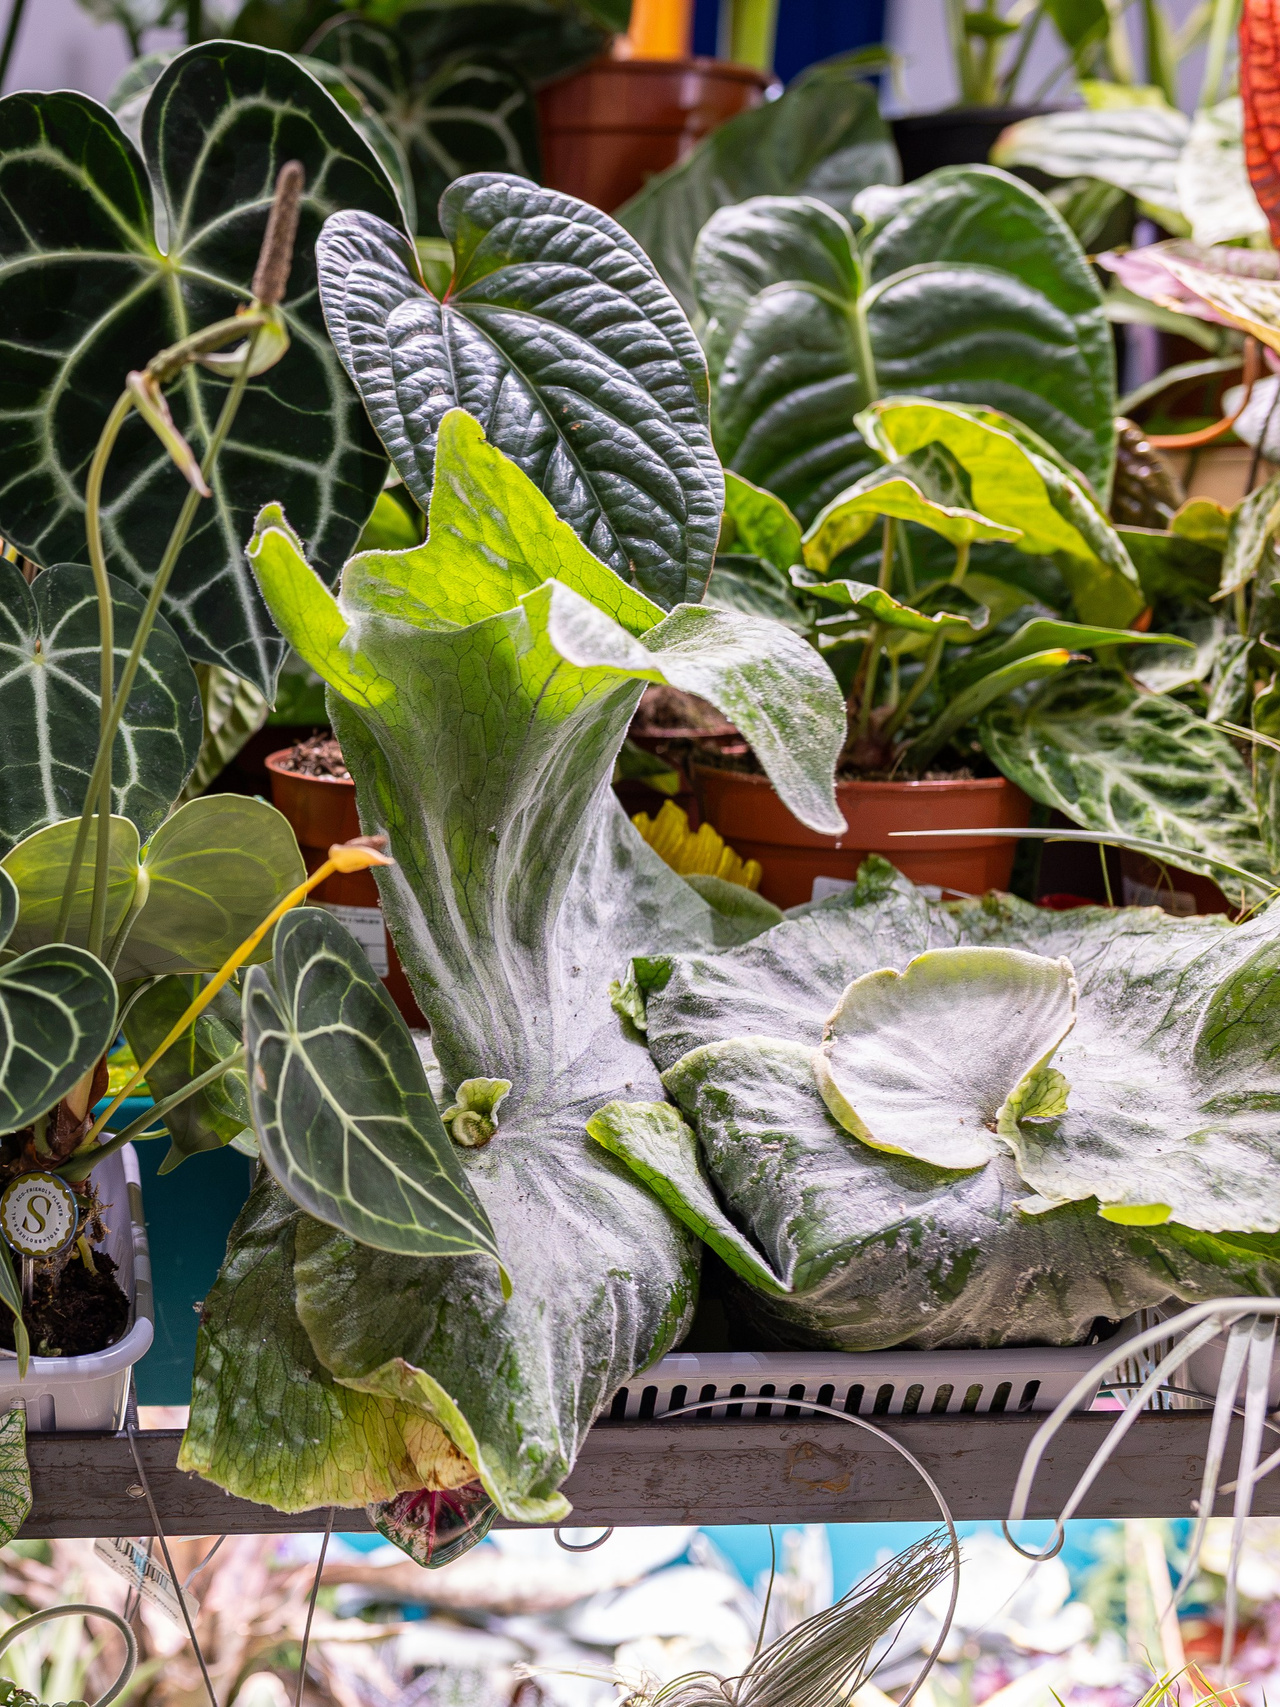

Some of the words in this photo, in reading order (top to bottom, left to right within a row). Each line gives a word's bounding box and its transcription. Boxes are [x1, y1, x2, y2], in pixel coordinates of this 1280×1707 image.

[16, 1187, 51, 1202] ECO-FRIENDLY
[52, 1195, 63, 1216] PLANTS
[22, 1195, 52, 1234] S
